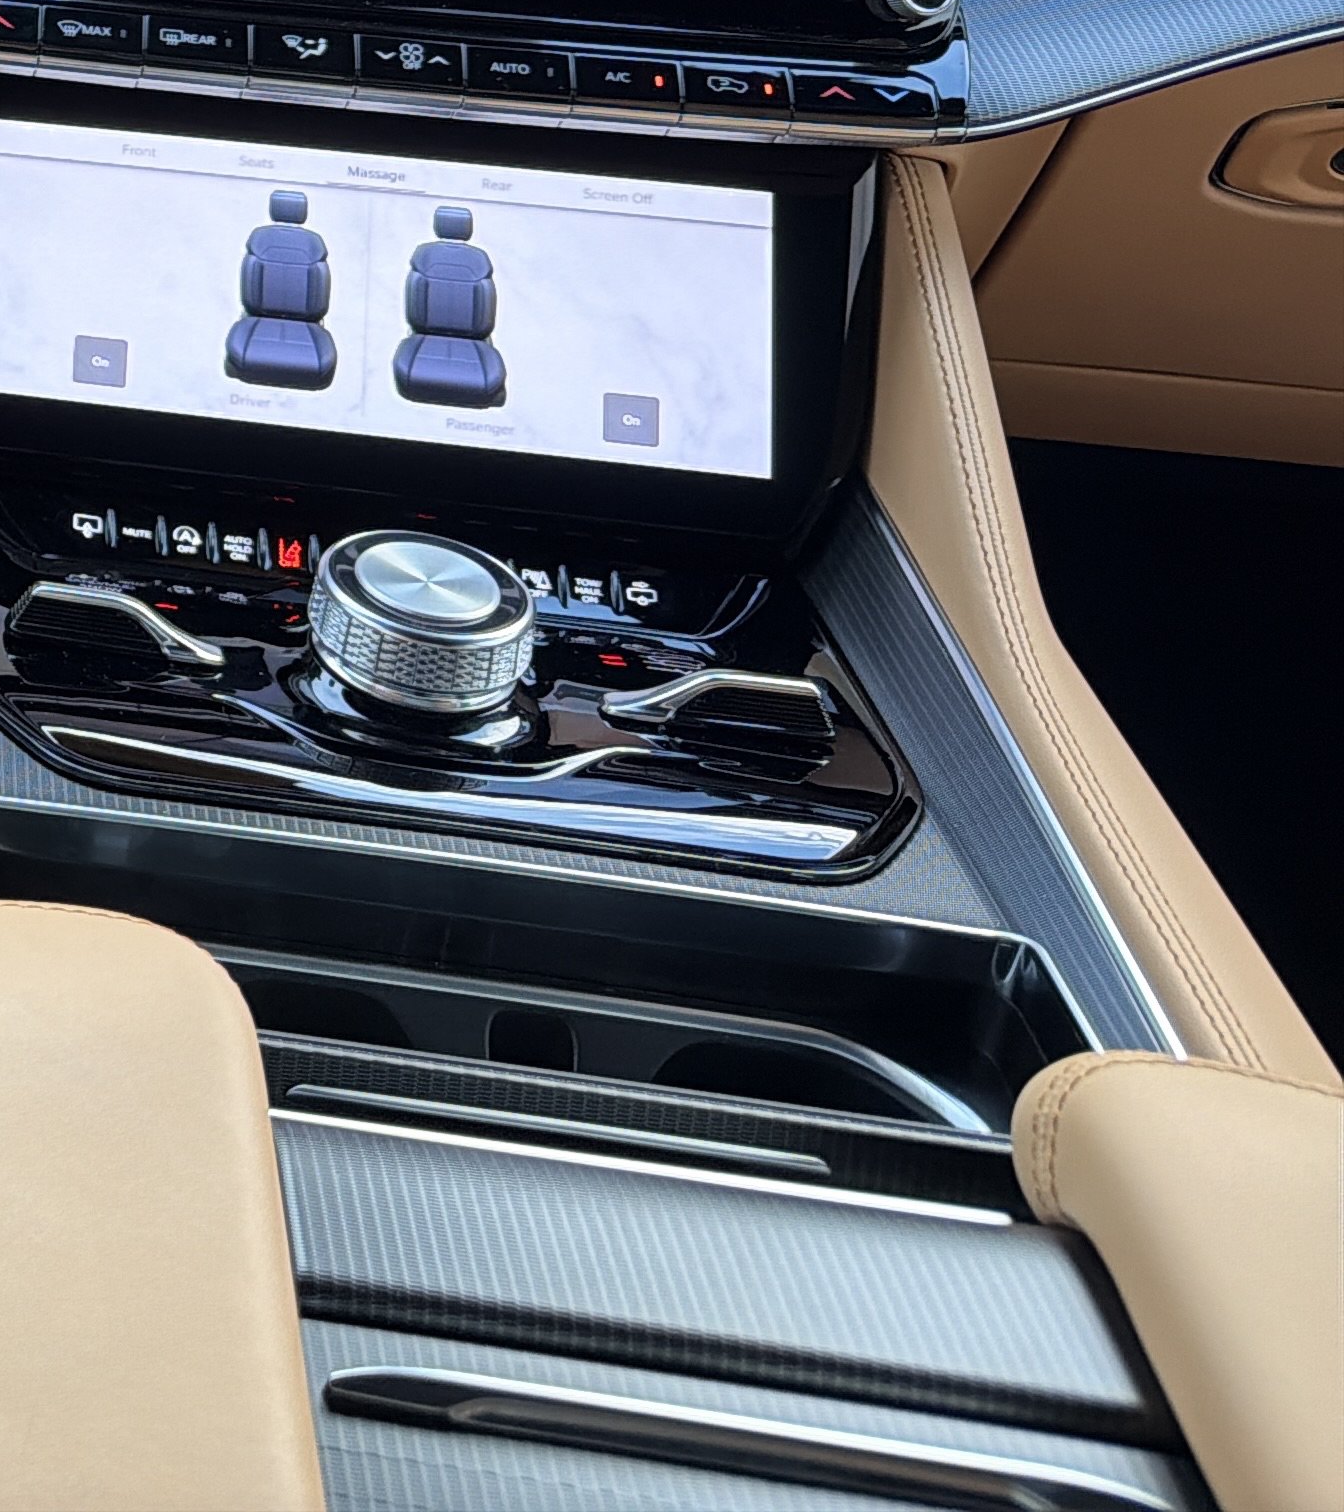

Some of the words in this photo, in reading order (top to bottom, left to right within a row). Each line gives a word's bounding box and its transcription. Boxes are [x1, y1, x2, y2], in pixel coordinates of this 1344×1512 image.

[82, 24, 112, 38] MAX
[182, 33, 217, 46] REAR
[489, 61, 531, 75] AUTO
[604, 71, 633, 84] A/C
[238, 153, 275, 171] Seats
[346, 164, 407, 187] Massage
[480, 177, 513, 194] Rear
[582, 186, 625, 205] Screen
[628, 189, 655, 207] Off
[90, 354, 110, 369] On
[229, 392, 271, 410] Driver
[621, 412, 642, 427] On
[444, 416, 516, 439] Passenger
[122, 526, 153, 540] MUTE
